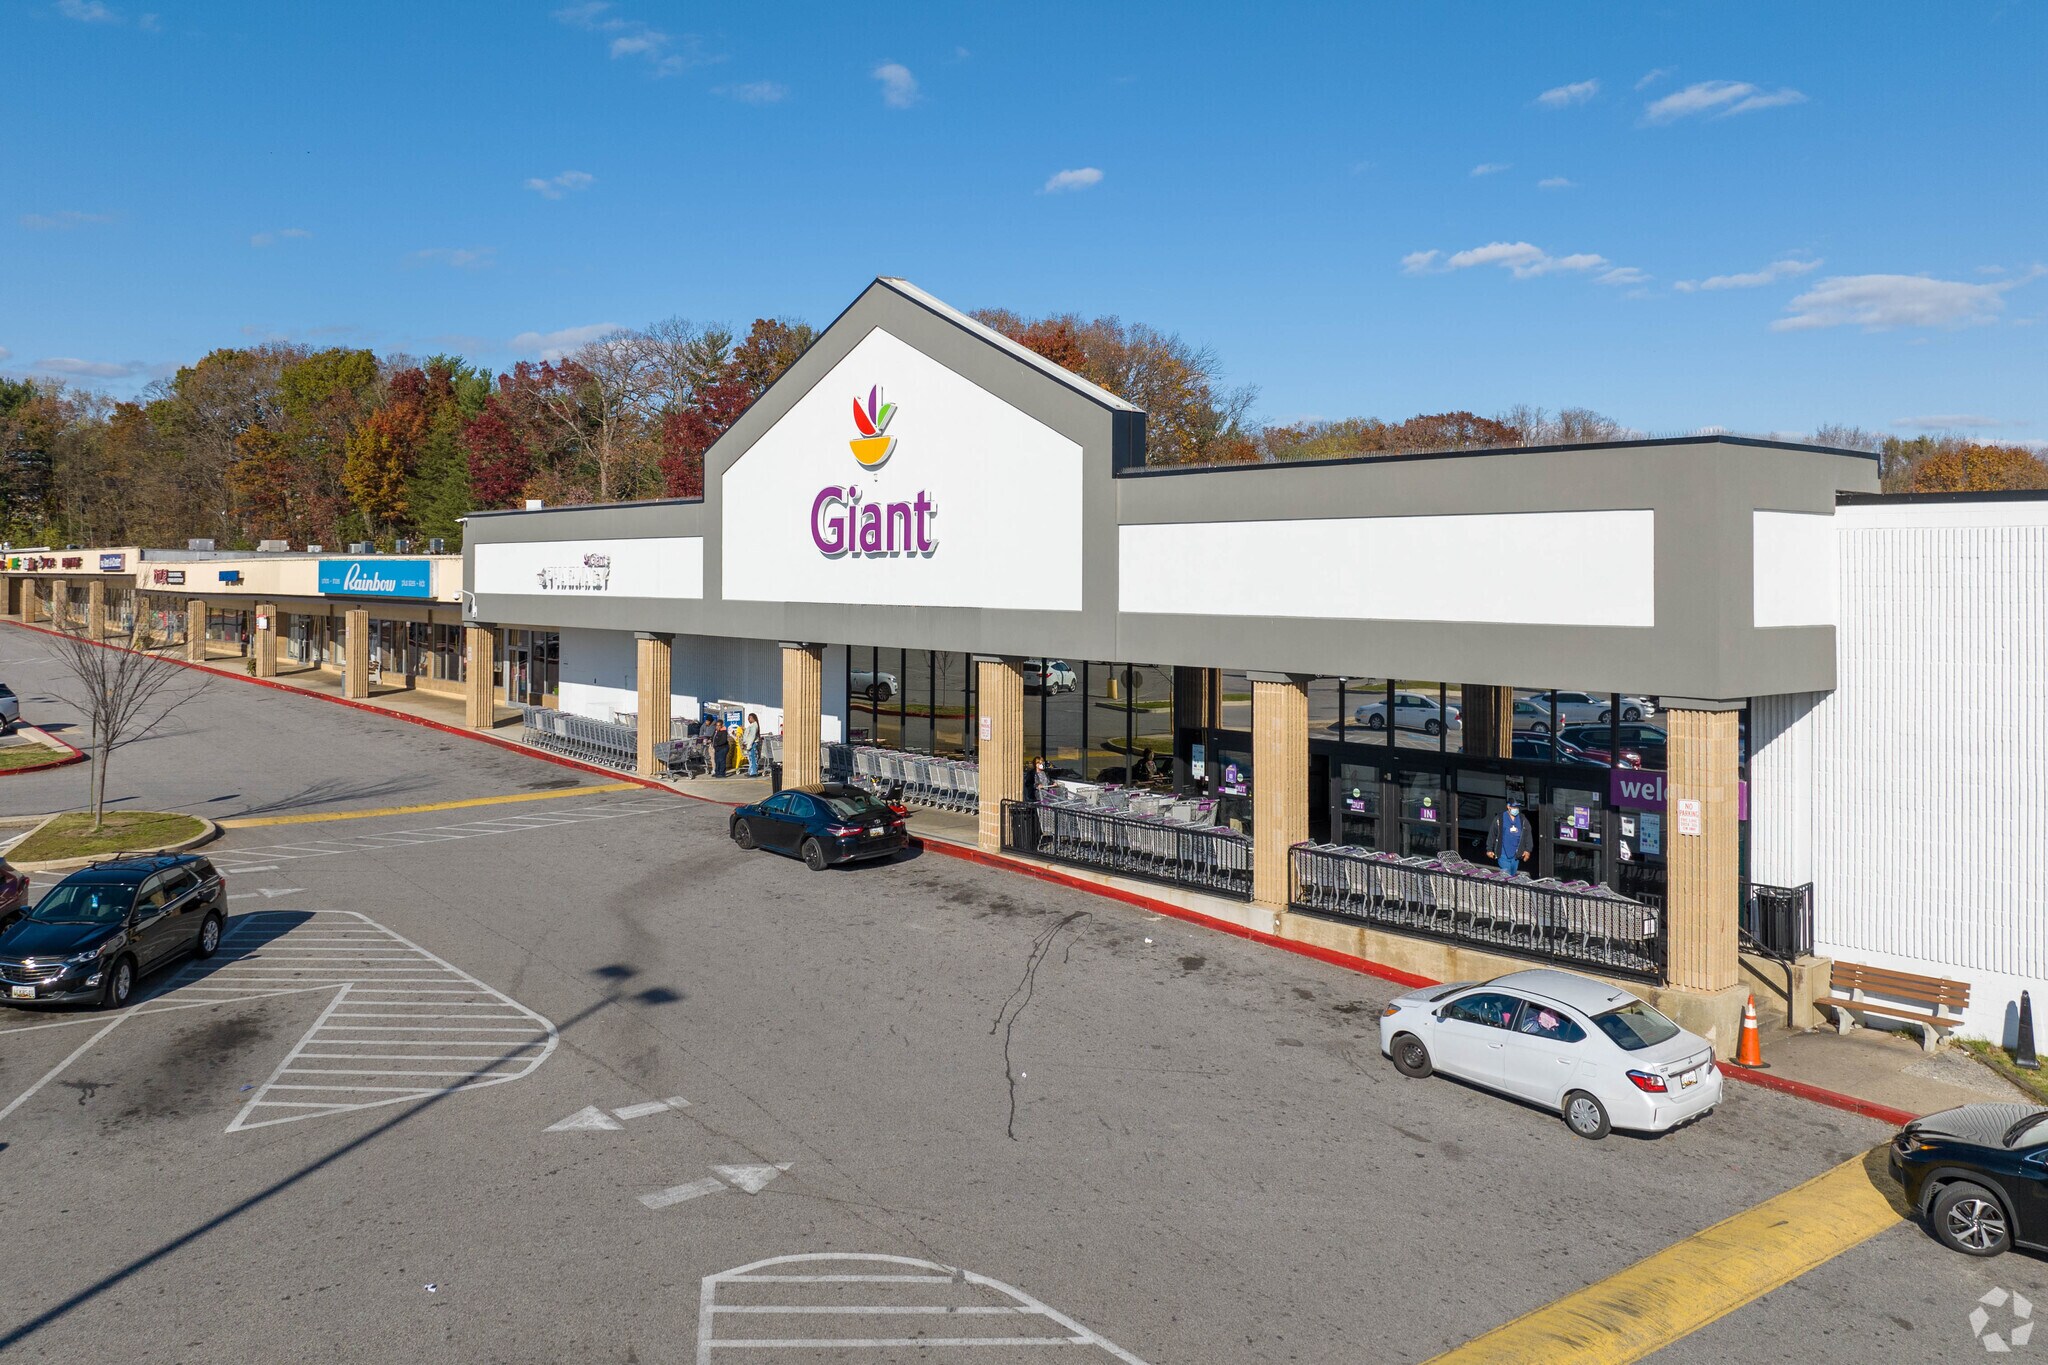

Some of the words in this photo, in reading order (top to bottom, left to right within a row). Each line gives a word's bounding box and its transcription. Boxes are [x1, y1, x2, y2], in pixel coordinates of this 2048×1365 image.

[810, 485, 934, 554] Giant
[343, 562, 396, 592] Rainbow
[1423, 808, 1433, 818] IN
[1679, 810, 1699, 818] PARKING
